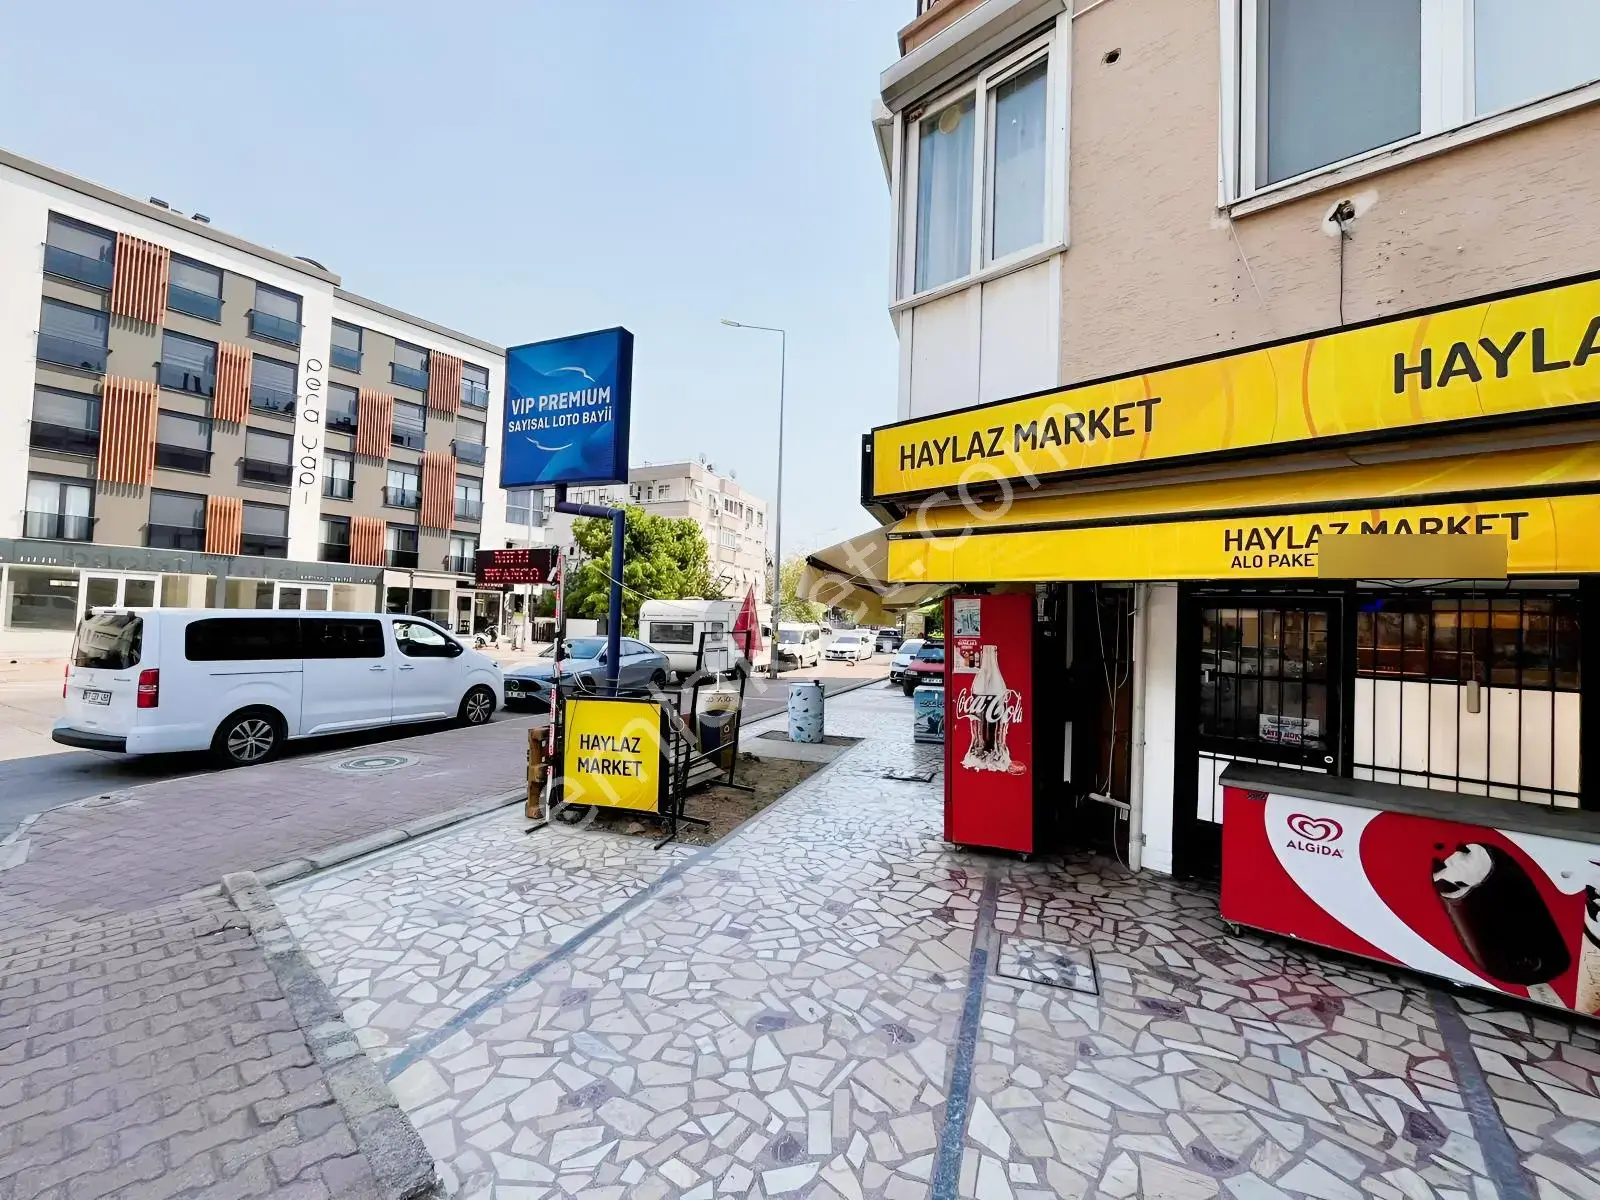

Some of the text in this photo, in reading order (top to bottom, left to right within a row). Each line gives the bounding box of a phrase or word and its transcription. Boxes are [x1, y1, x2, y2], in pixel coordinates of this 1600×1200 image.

[511, 385, 611, 416] VIP PREMIUM
[508, 416, 551, 433] SAYISAL
[552, 413, 580, 428] LOTO
[899, 396, 1162, 472] HAYLAZ MARKET
[1230, 554, 1263, 569] ALO
[579, 733, 641, 754] HAYLAZ
[577, 756, 643, 777] MARKET
